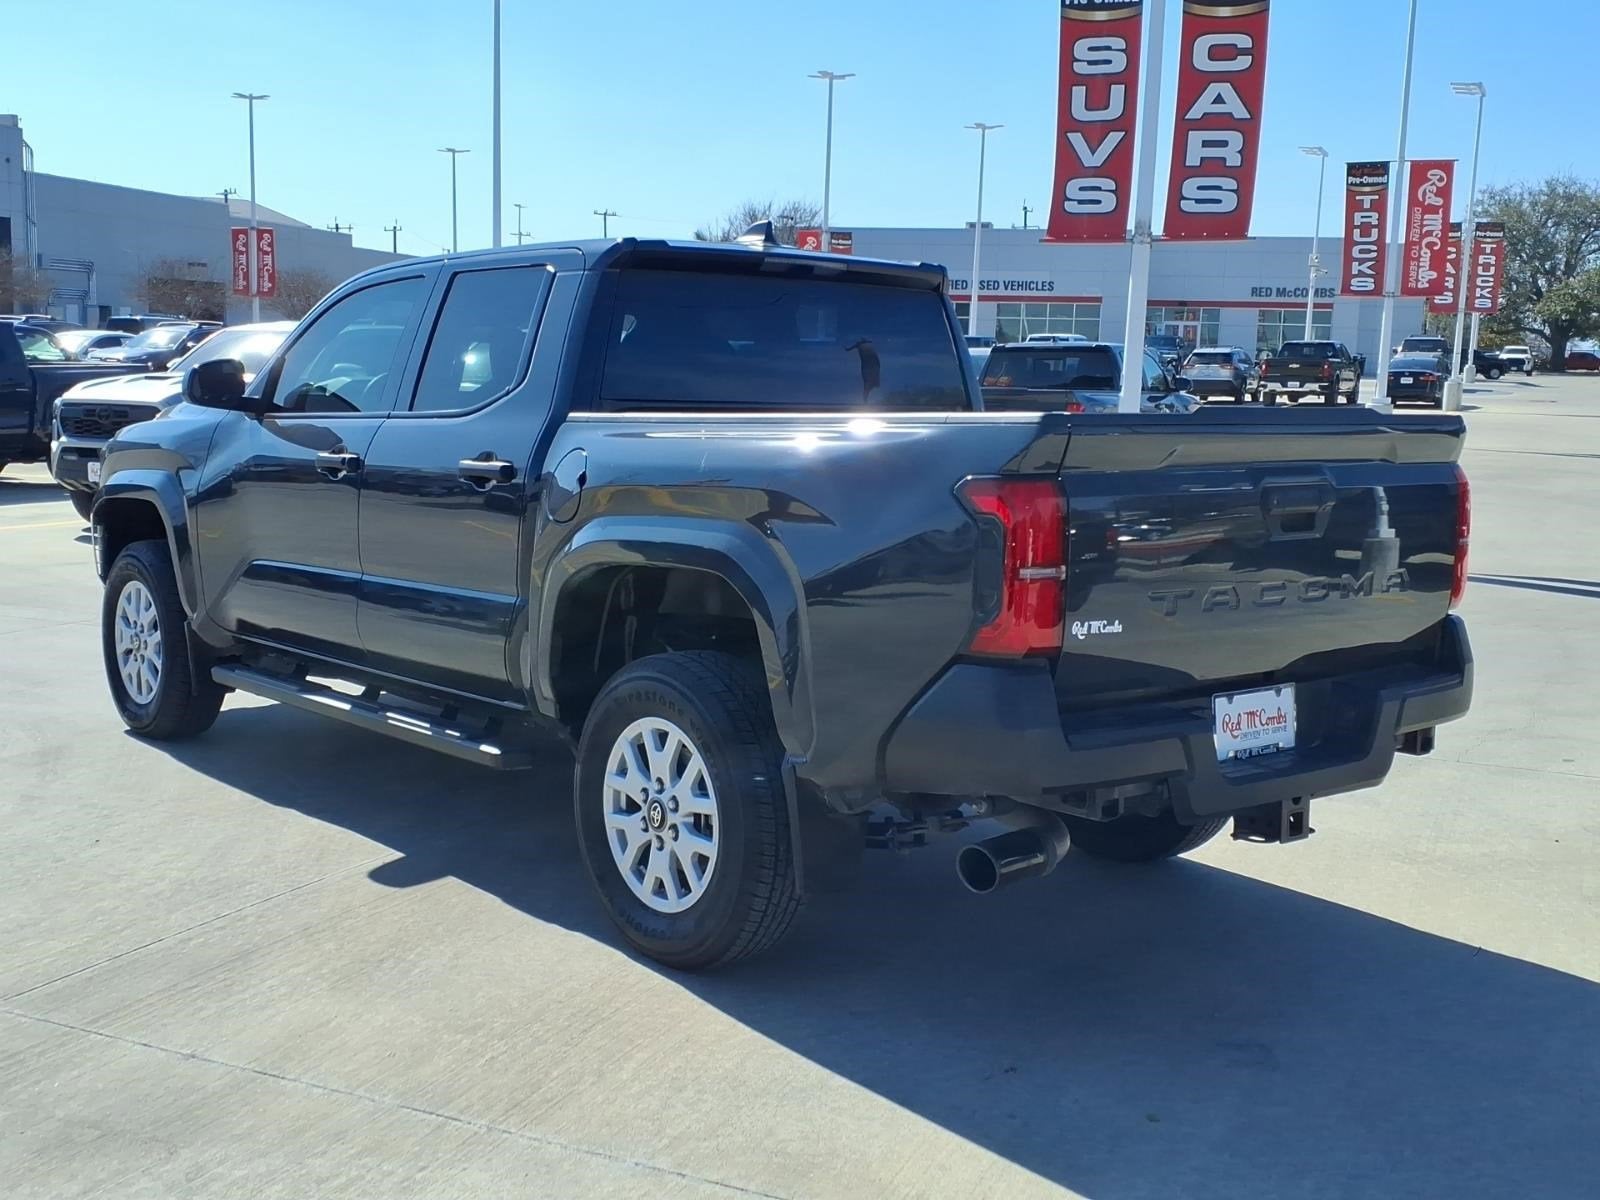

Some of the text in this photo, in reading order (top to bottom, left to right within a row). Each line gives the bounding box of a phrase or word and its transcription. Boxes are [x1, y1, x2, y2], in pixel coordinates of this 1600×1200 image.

[1064, 36, 1128, 214] SUVS
[1180, 33, 1253, 214] CARS
[1350, 195, 1379, 291] TRUCKS
[1408, 207, 1422, 288] DRIVEN TO SERVE
[1417, 169, 1447, 288] Red McCombs
[1003, 281, 1055, 292] VEHICLES
[1251, 287, 1273, 297] RED
[1474, 244, 1497, 308] TRUCKS
[1148, 567, 1410, 617] TACOMA
[1072, 620, 1088, 640] Red
[1222, 707, 1287, 739] Red McCombs
[1240, 730, 1261, 741] DRIVEN
